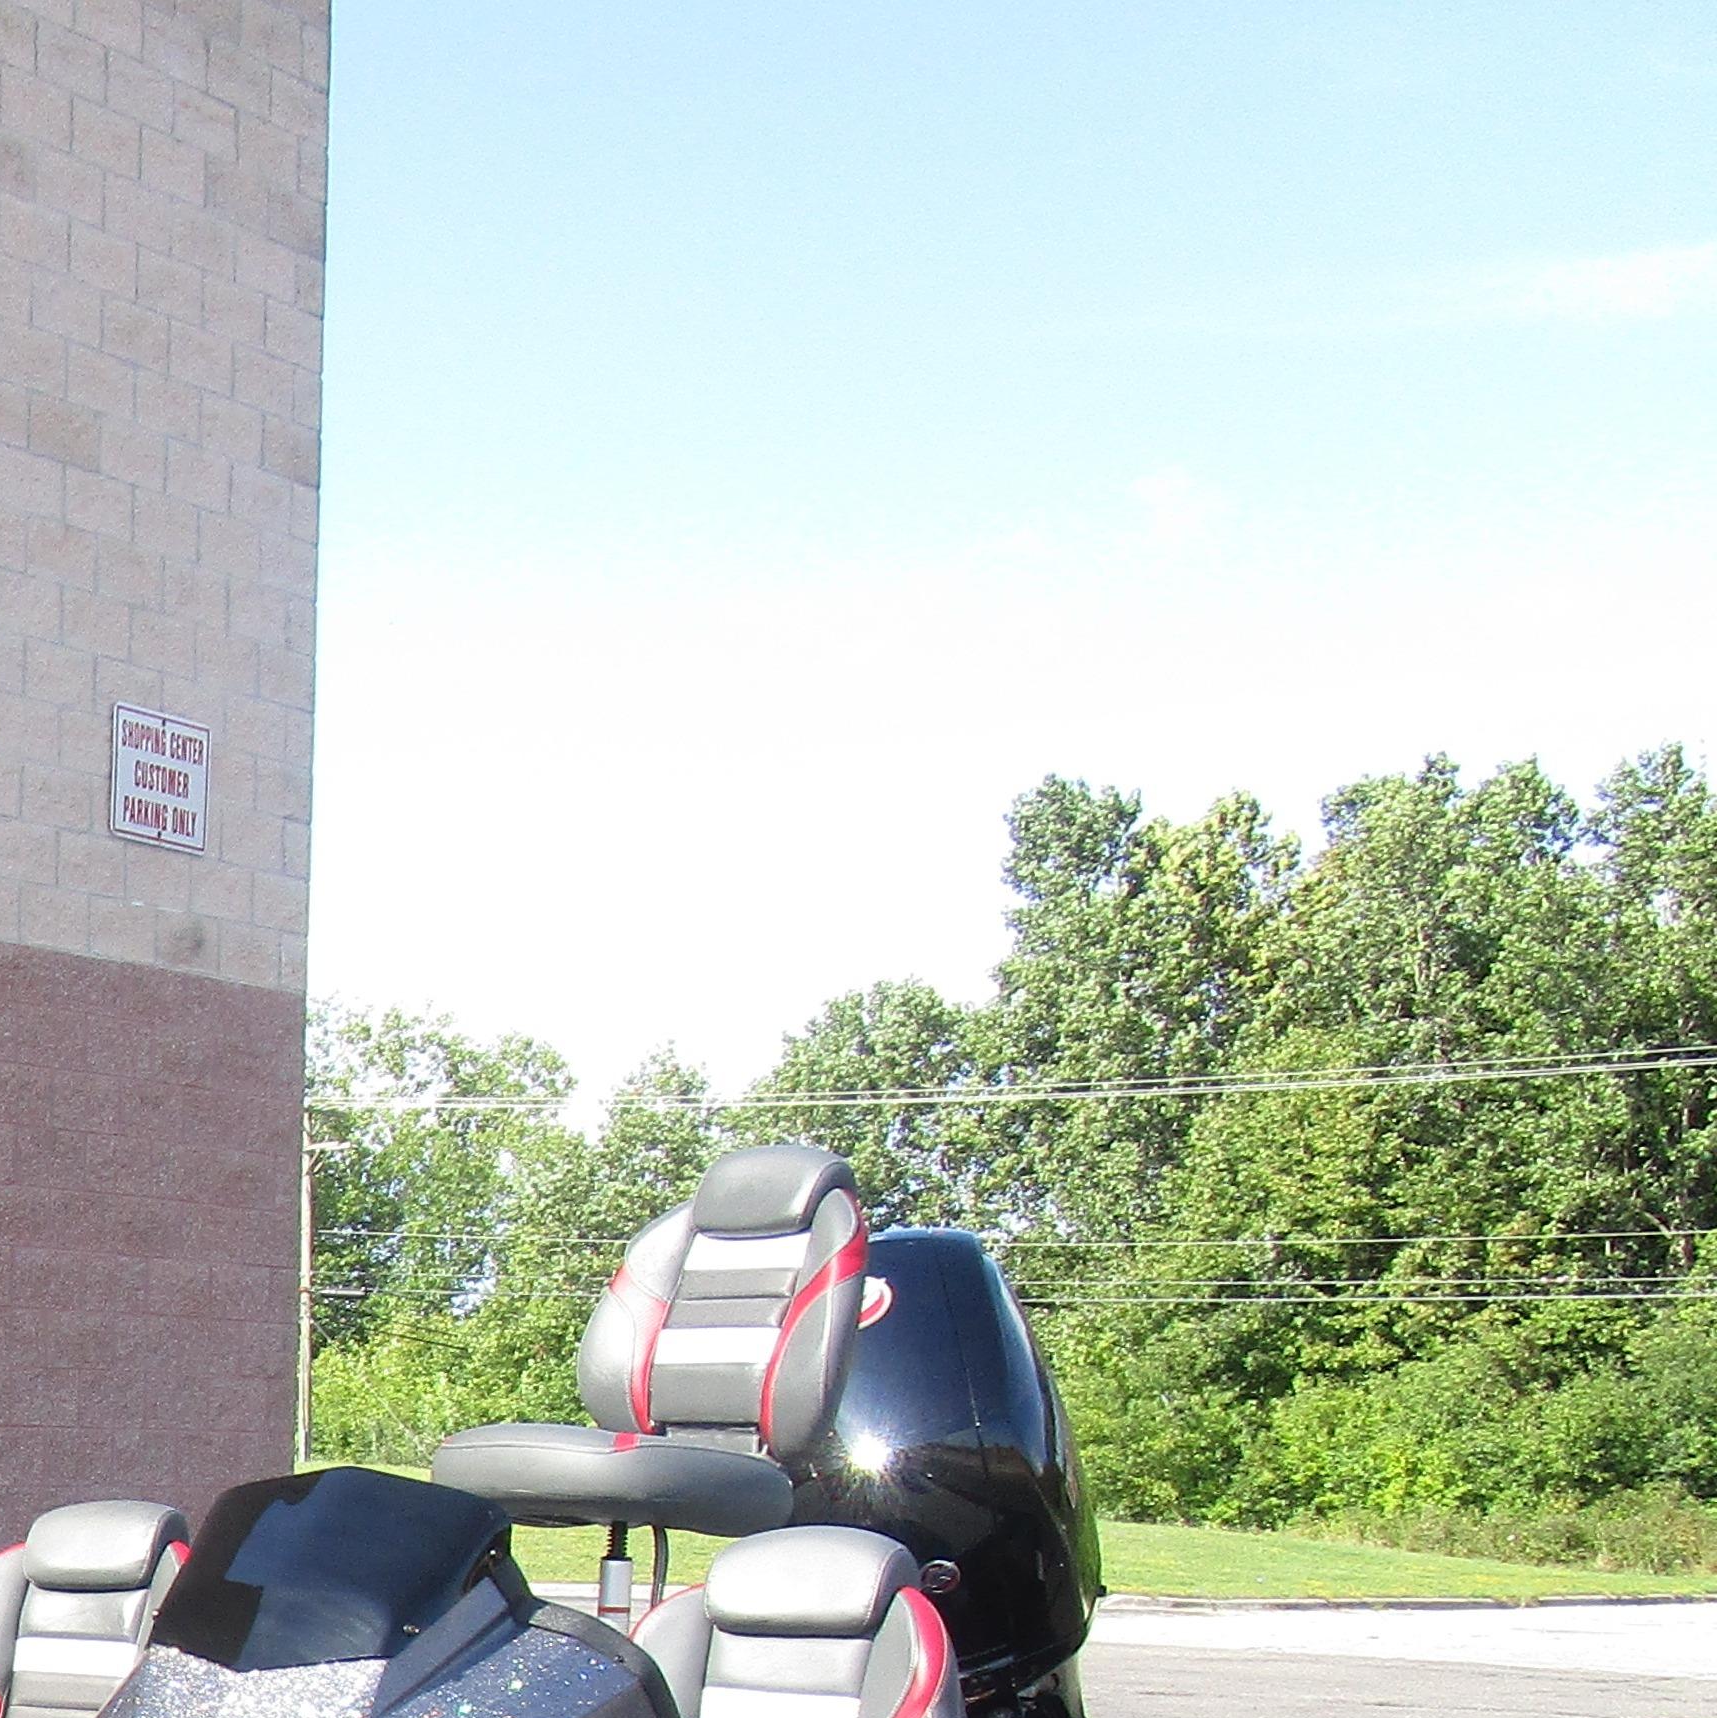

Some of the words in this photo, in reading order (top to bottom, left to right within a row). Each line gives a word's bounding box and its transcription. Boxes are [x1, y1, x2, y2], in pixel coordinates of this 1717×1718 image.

[122, 719, 167, 756] SHOPPING
[170, 732, 204, 766] CENTER
[134, 760, 189, 799] CUSTOMER
[122, 796, 168, 831] PARKING
[172, 807, 197, 837] ONLY
